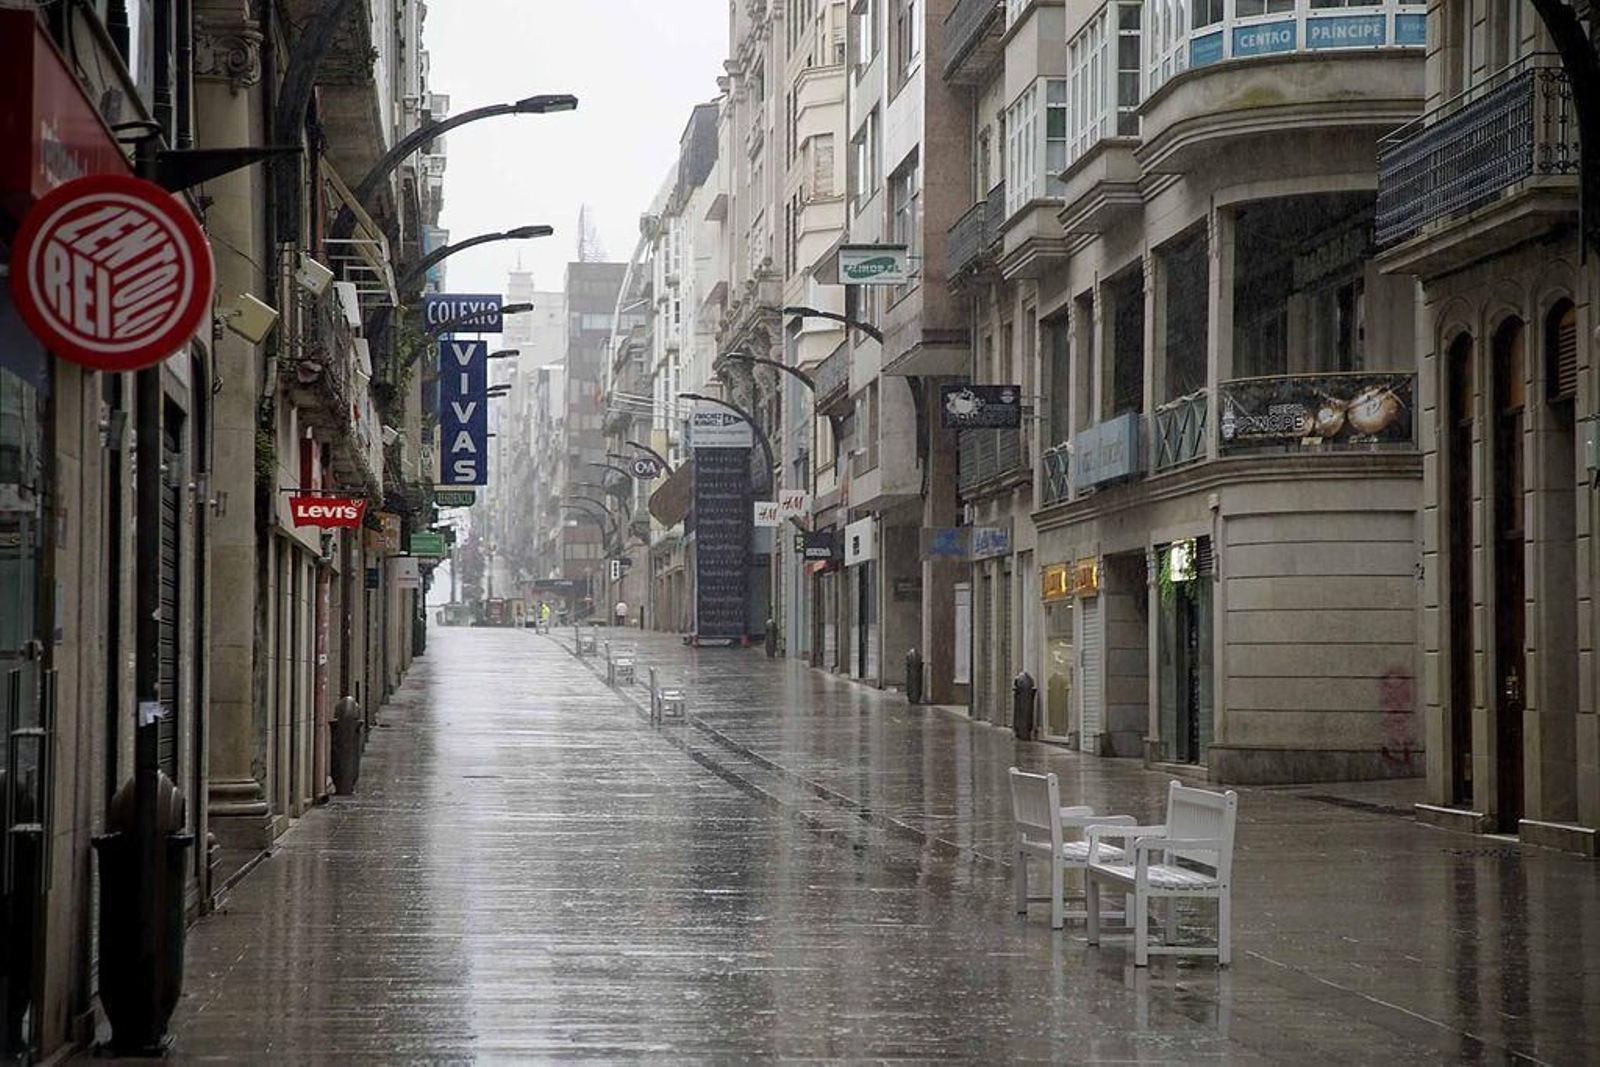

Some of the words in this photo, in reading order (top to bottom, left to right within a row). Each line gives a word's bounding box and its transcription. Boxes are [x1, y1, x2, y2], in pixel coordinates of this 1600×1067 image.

[1240, 29, 1292, 48] CENTRO
[1311, 22, 1381, 40] PRÍNCIPE
[43, 237, 112, 340] REI
[427, 300, 500, 325] COLEXIO
[450, 342, 478, 483] VIVAS
